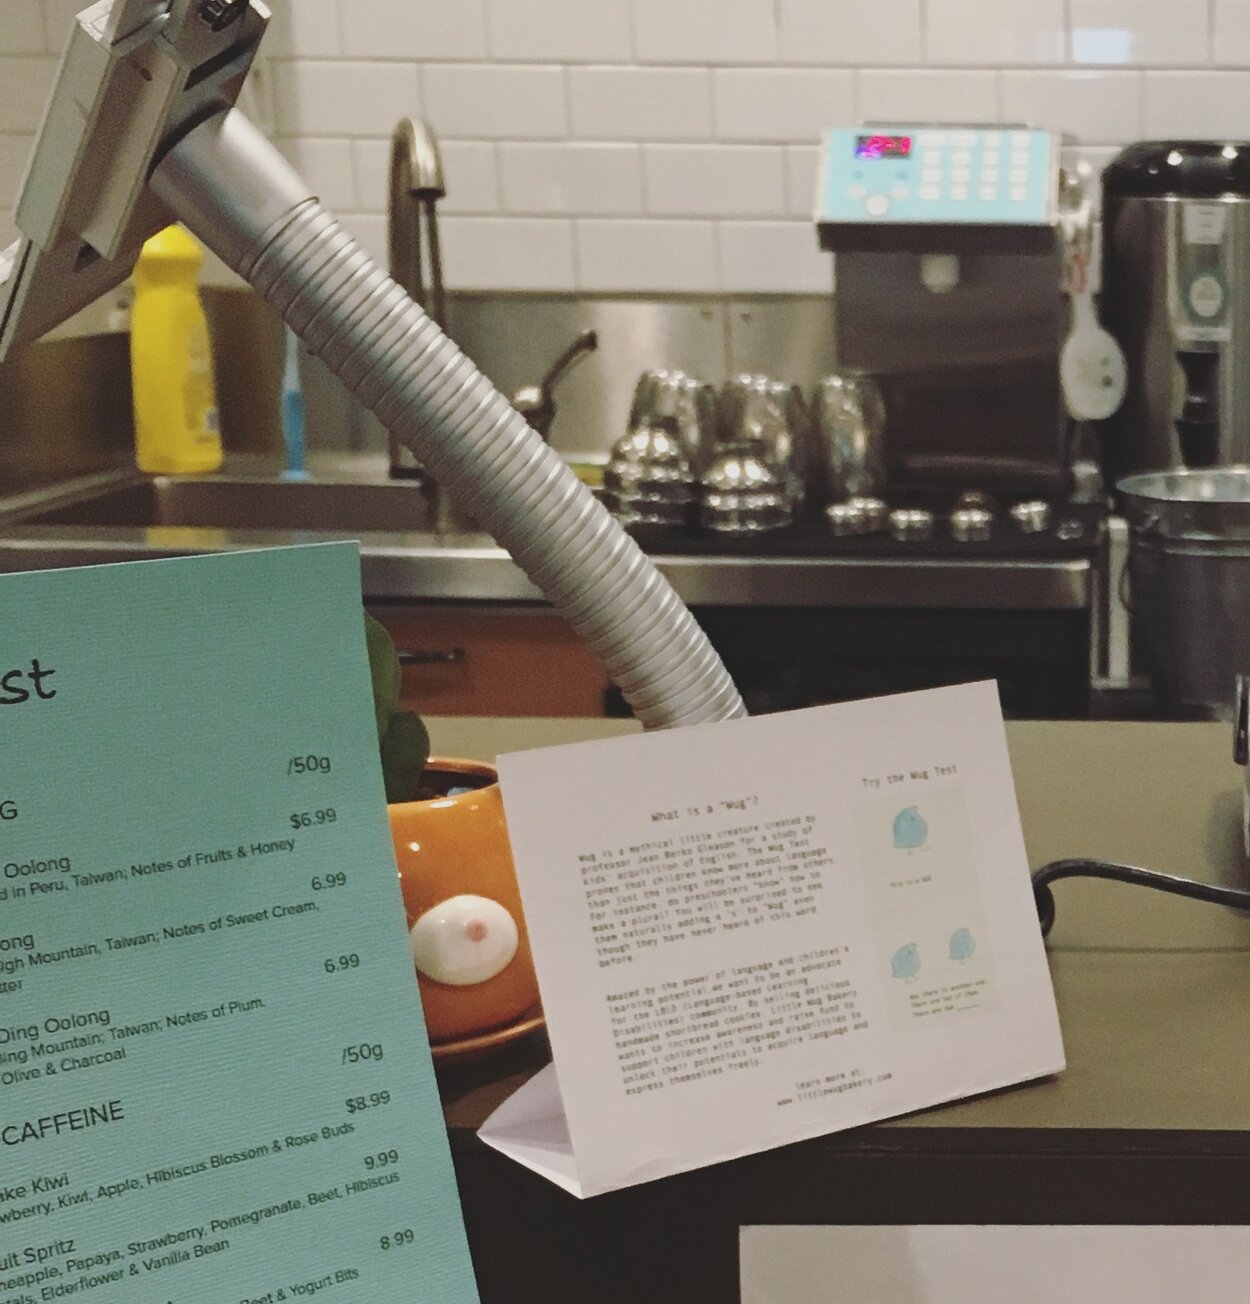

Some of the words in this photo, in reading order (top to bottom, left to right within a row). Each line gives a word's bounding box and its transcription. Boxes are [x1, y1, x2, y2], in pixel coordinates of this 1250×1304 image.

[287, 755, 331, 776] /50g
[862, 778, 880, 788] Try
[886, 774, 905, 784] the
[909, 770, 929, 780] Wug
[934, 765, 957, 775] Test
[290, 807, 337, 829] $6.99
[4, 857, 71, 878] Oolong
[12, 887, 26, 898] in
[131, 861, 174, 877] Notes
[177, 855, 192, 868] of
[195, 850, 233, 865] Fruits
[236, 846, 247, 859] &
[250, 839, 295, 855] Honey
[311, 871, 347, 891] 6.99
[162, 923, 205, 939] Notes
[208, 917, 222, 931] of
[225, 909, 269, 927] Sweet
[324, 953, 360, 974] 6.99
[44, 1010, 110, 1033] Oolong
[165, 1011, 208, 1027] Notes
[211, 1004, 225, 1017] of
[0, 1068, 41, 1085] Olive
[45, 1062, 58, 1075] &
[60, 1046, 126, 1072] Charcoal
[341, 1043, 383, 1065] /50g
[346, 1090, 390, 1114] $8.99
[0, 1100, 125, 1146] CAFFEINE
[145, 1162, 208, 1185] Hibiscus
[210, 1145, 269, 1168] Blossom
[271, 1140, 283, 1153] &
[284, 1133, 319, 1148] Rose
[321, 1123, 355, 1139] Buds
[365, 1149, 399, 1170] 9.99
[31, 1172, 70, 1194] Kiwi
[345, 1172, 400, 1195] Hibiscus
[23, 1239, 76, 1264] Spritz
[380, 1229, 414, 1251] 8.99
[41, 1269, 124, 1301] Elderflower
[129, 1263, 140, 1276] &
[142, 1251, 190, 1271] Vanilla
[193, 1240, 230, 1258] Bean
[276, 1289, 287, 1301] &
[289, 1275, 333, 1296] Yogurt
[334, 1269, 359, 1283] Bits
